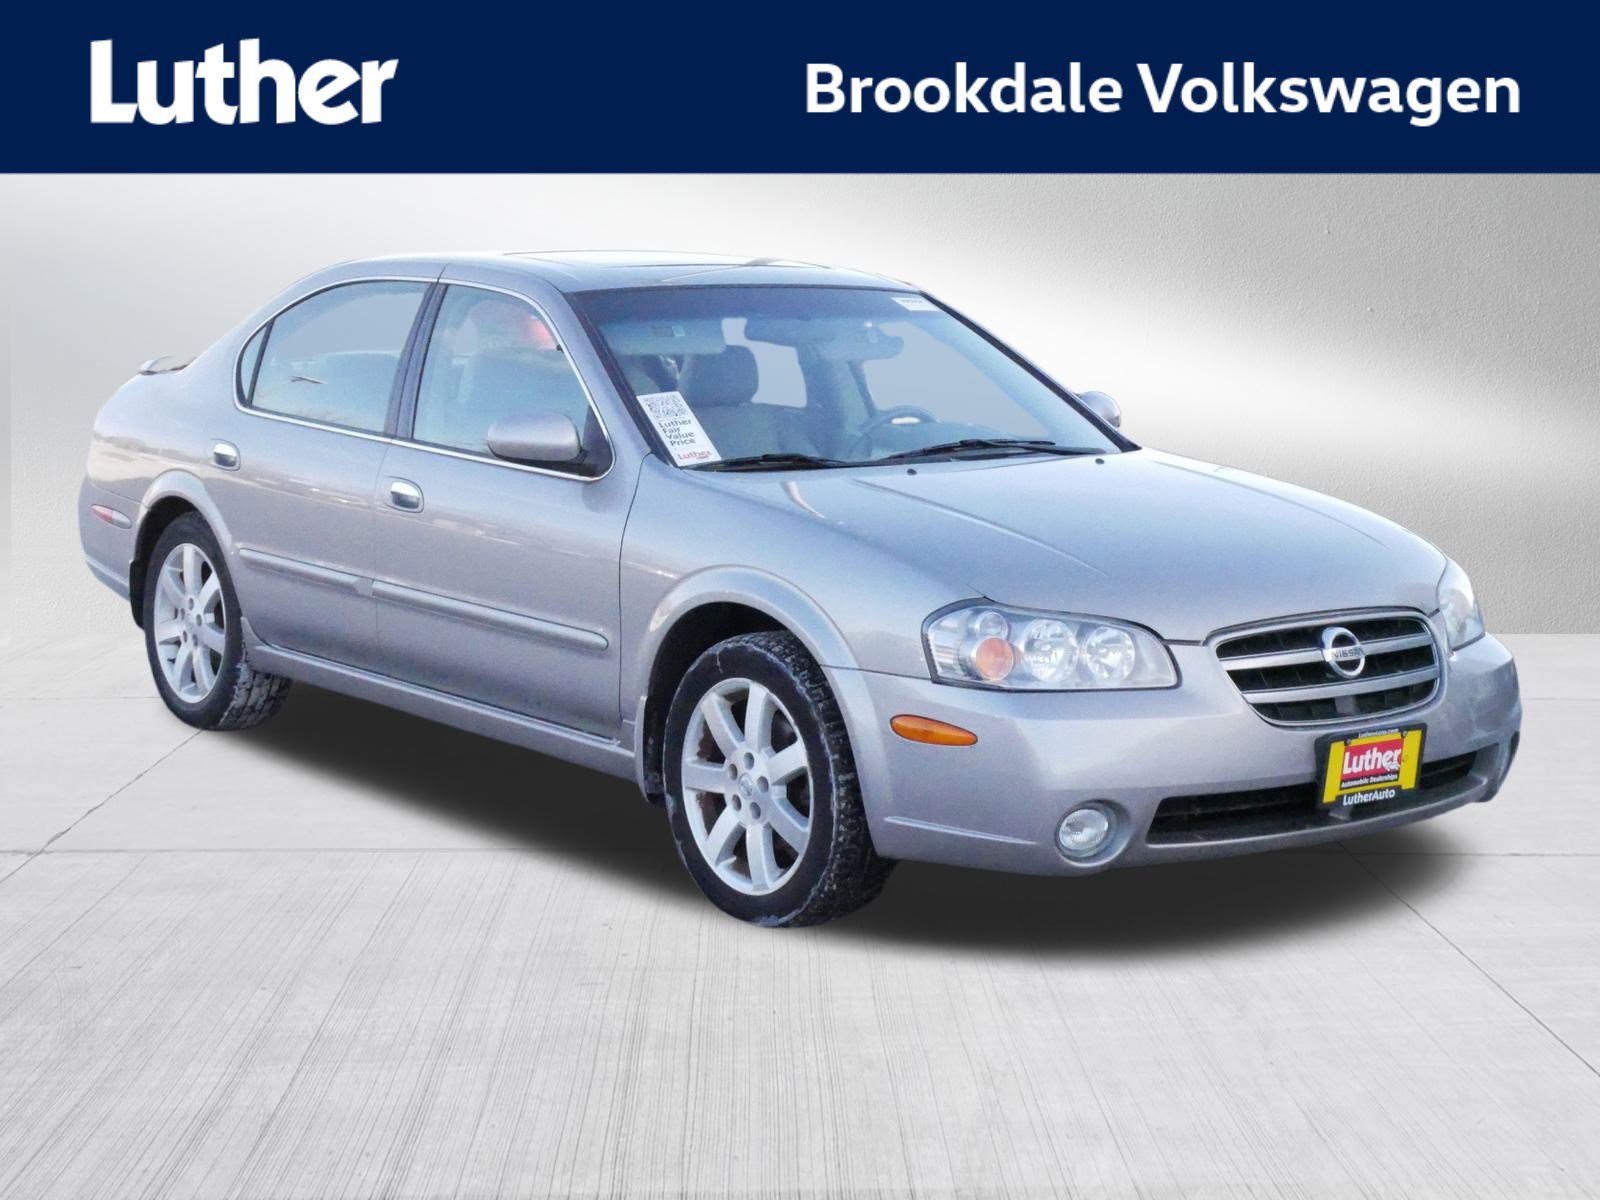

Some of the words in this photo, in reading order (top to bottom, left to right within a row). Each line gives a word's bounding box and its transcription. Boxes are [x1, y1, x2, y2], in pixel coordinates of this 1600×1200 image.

[659, 419, 692, 428] Luther
[665, 431, 695, 440] Value
[670, 438, 696, 447] Price
[677, 450, 712, 460] Luther
[1342, 747, 1402, 775] Luther
[1342, 788, 1396, 806] LutherAuto
